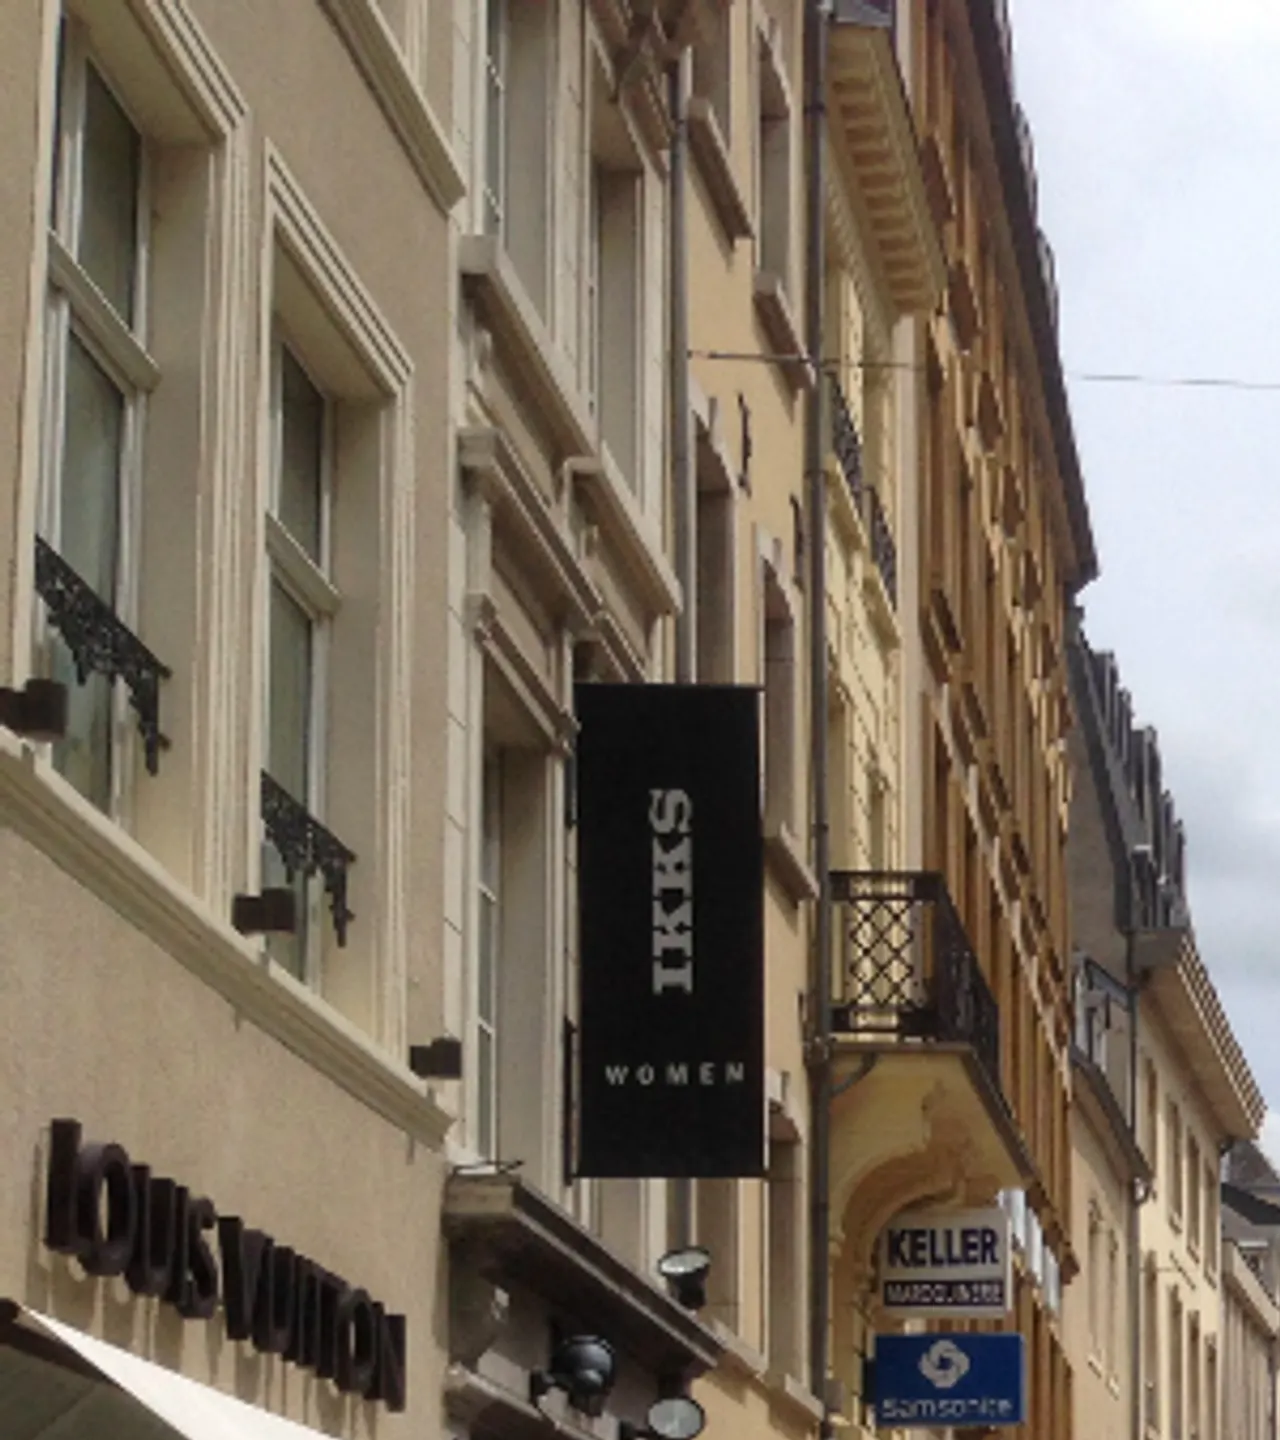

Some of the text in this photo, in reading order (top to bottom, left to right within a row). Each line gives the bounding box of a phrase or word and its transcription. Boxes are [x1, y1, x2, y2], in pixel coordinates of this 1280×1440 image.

[648, 788, 694, 994] IKKS
[604, 1063, 745, 1086] WOMEN
[44, 1118, 218, 1319] LOUIS
[886, 1228, 999, 1268] KELLER
